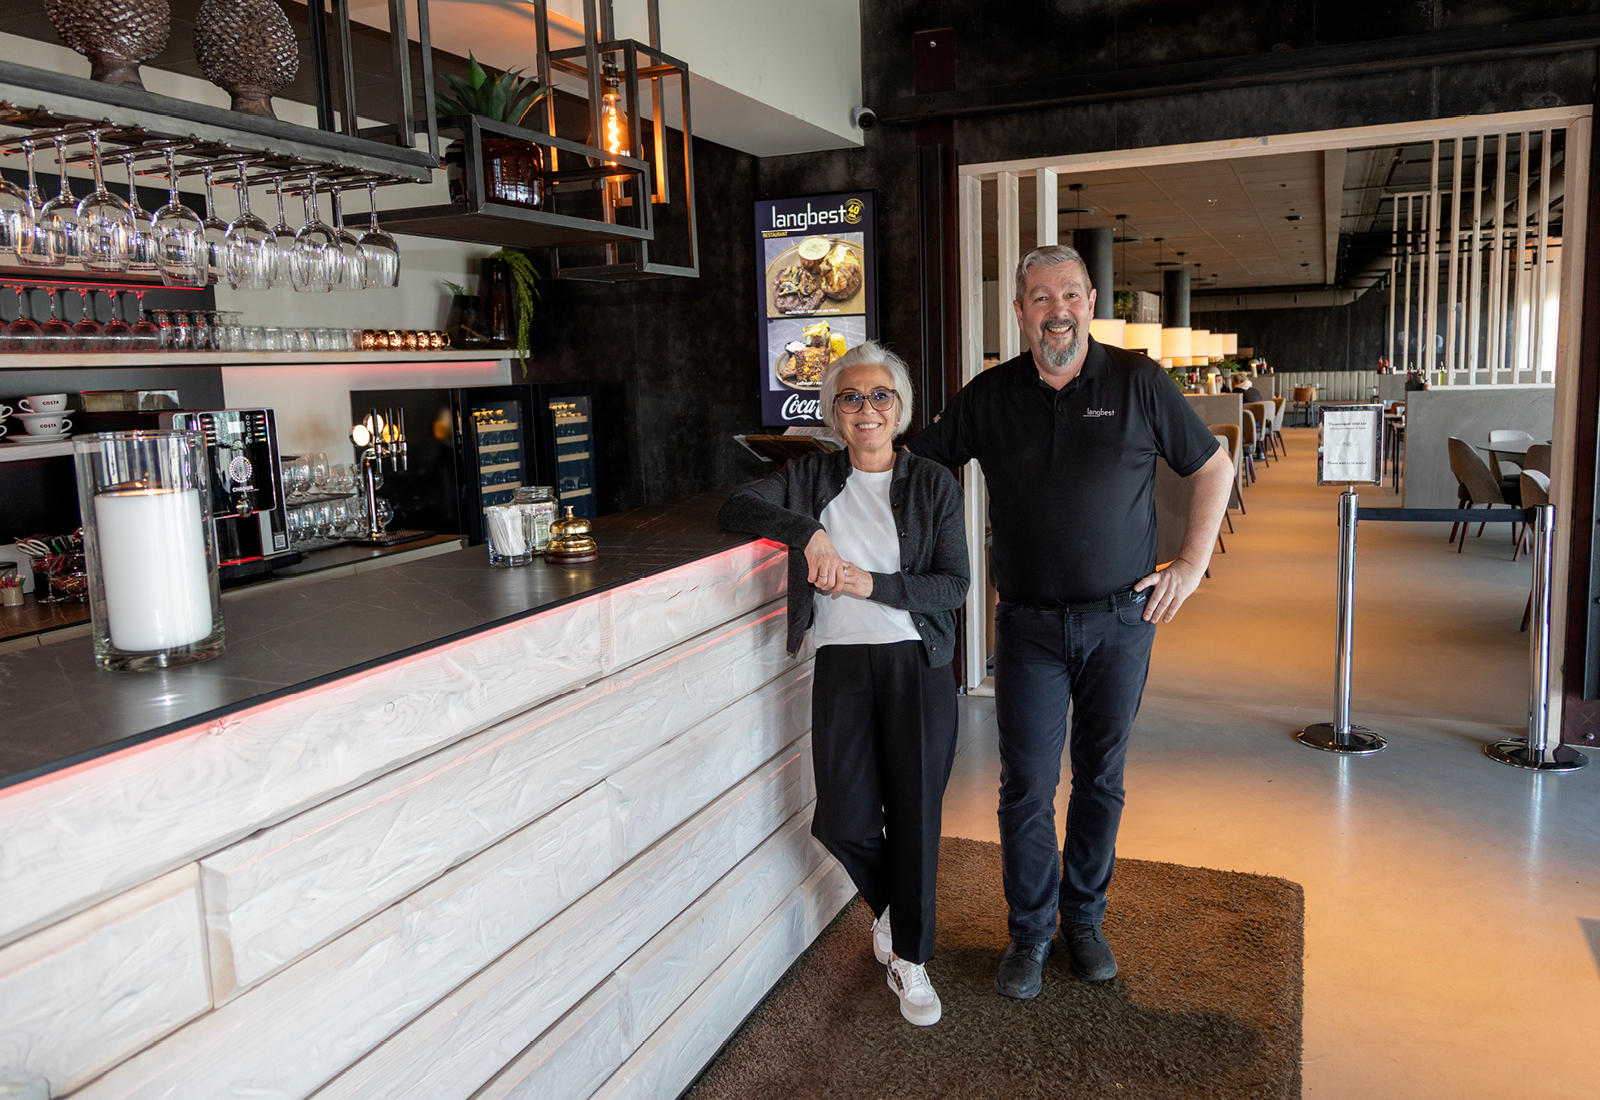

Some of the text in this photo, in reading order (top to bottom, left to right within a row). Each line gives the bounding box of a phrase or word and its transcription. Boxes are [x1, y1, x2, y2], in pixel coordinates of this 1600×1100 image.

[848, 204, 860, 215] 40
[763, 202, 847, 231] langbest
[1084, 407, 1115, 418] langbest
